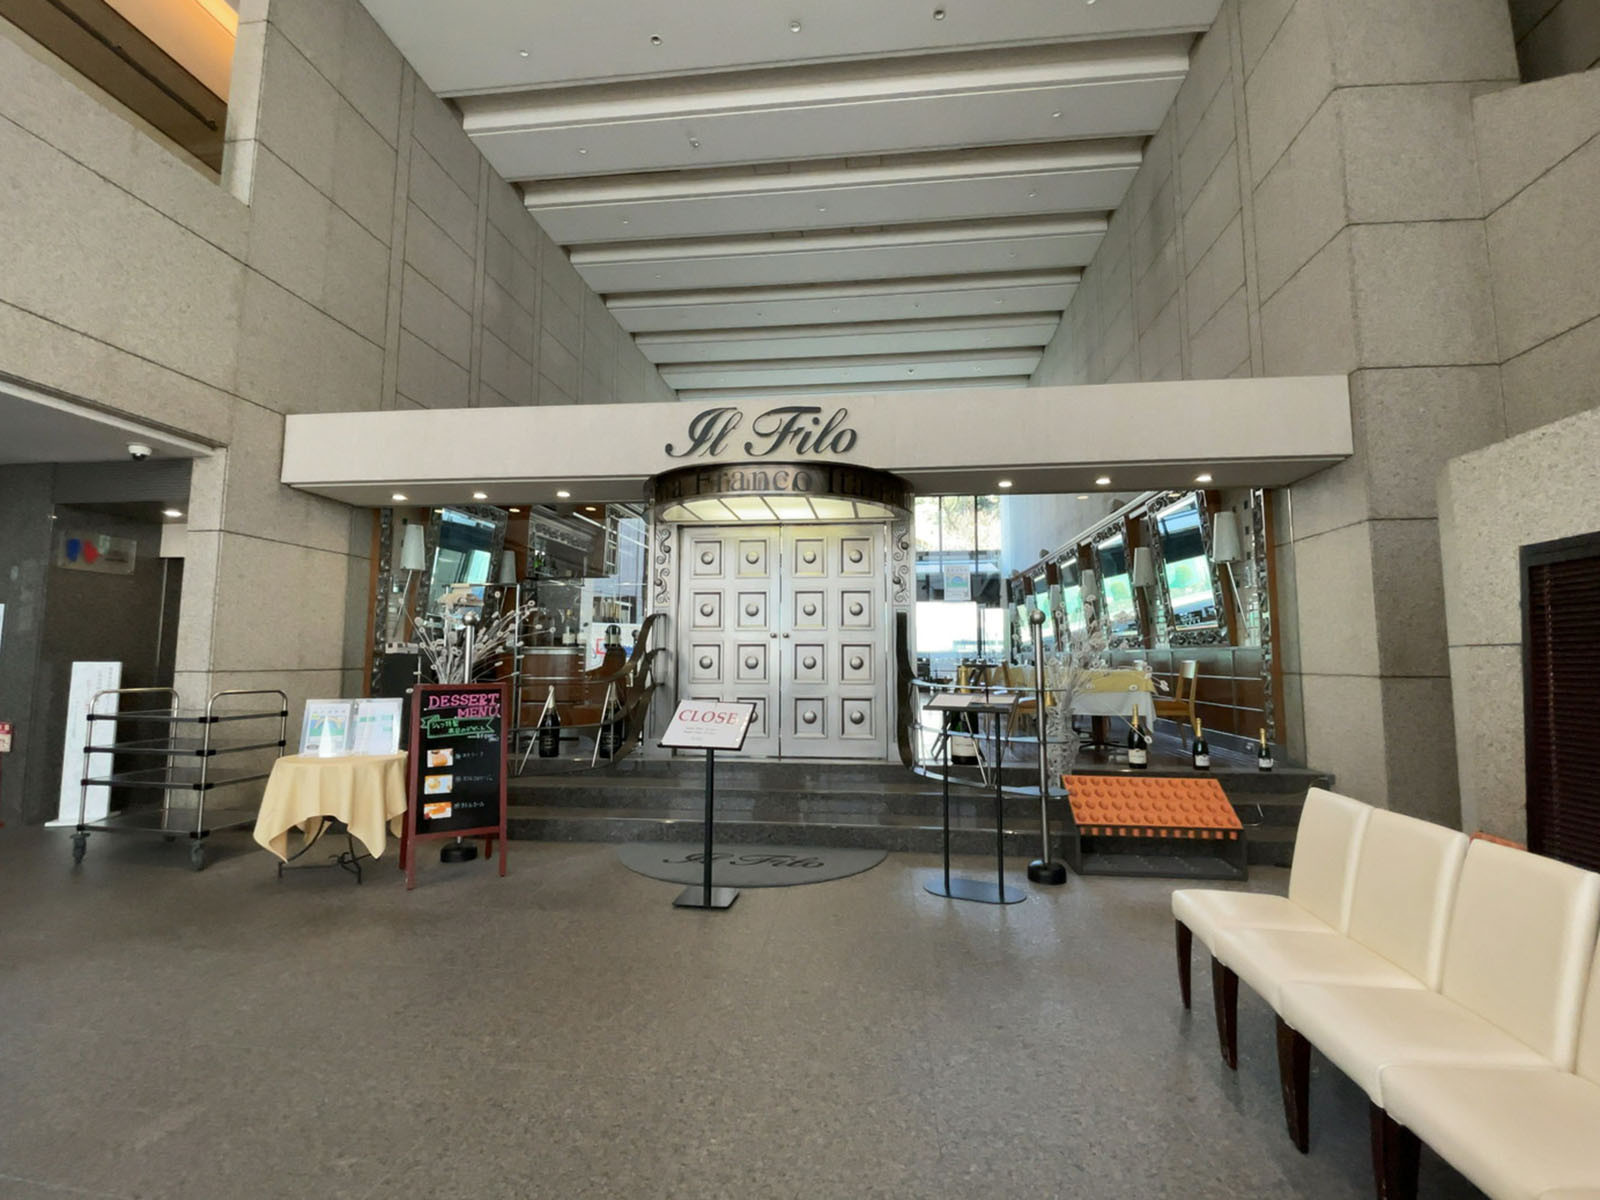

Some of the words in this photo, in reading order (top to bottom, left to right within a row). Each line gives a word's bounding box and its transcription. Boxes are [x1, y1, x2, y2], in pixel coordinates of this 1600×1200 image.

[664, 406, 744, 458] Il
[744, 405, 858, 457] Filo
[428, 693, 500, 709] DESSERT
[457, 706, 500, 718] MENU
[678, 709, 738, 724] CLOSE
[729, 854, 825, 868] Filo
